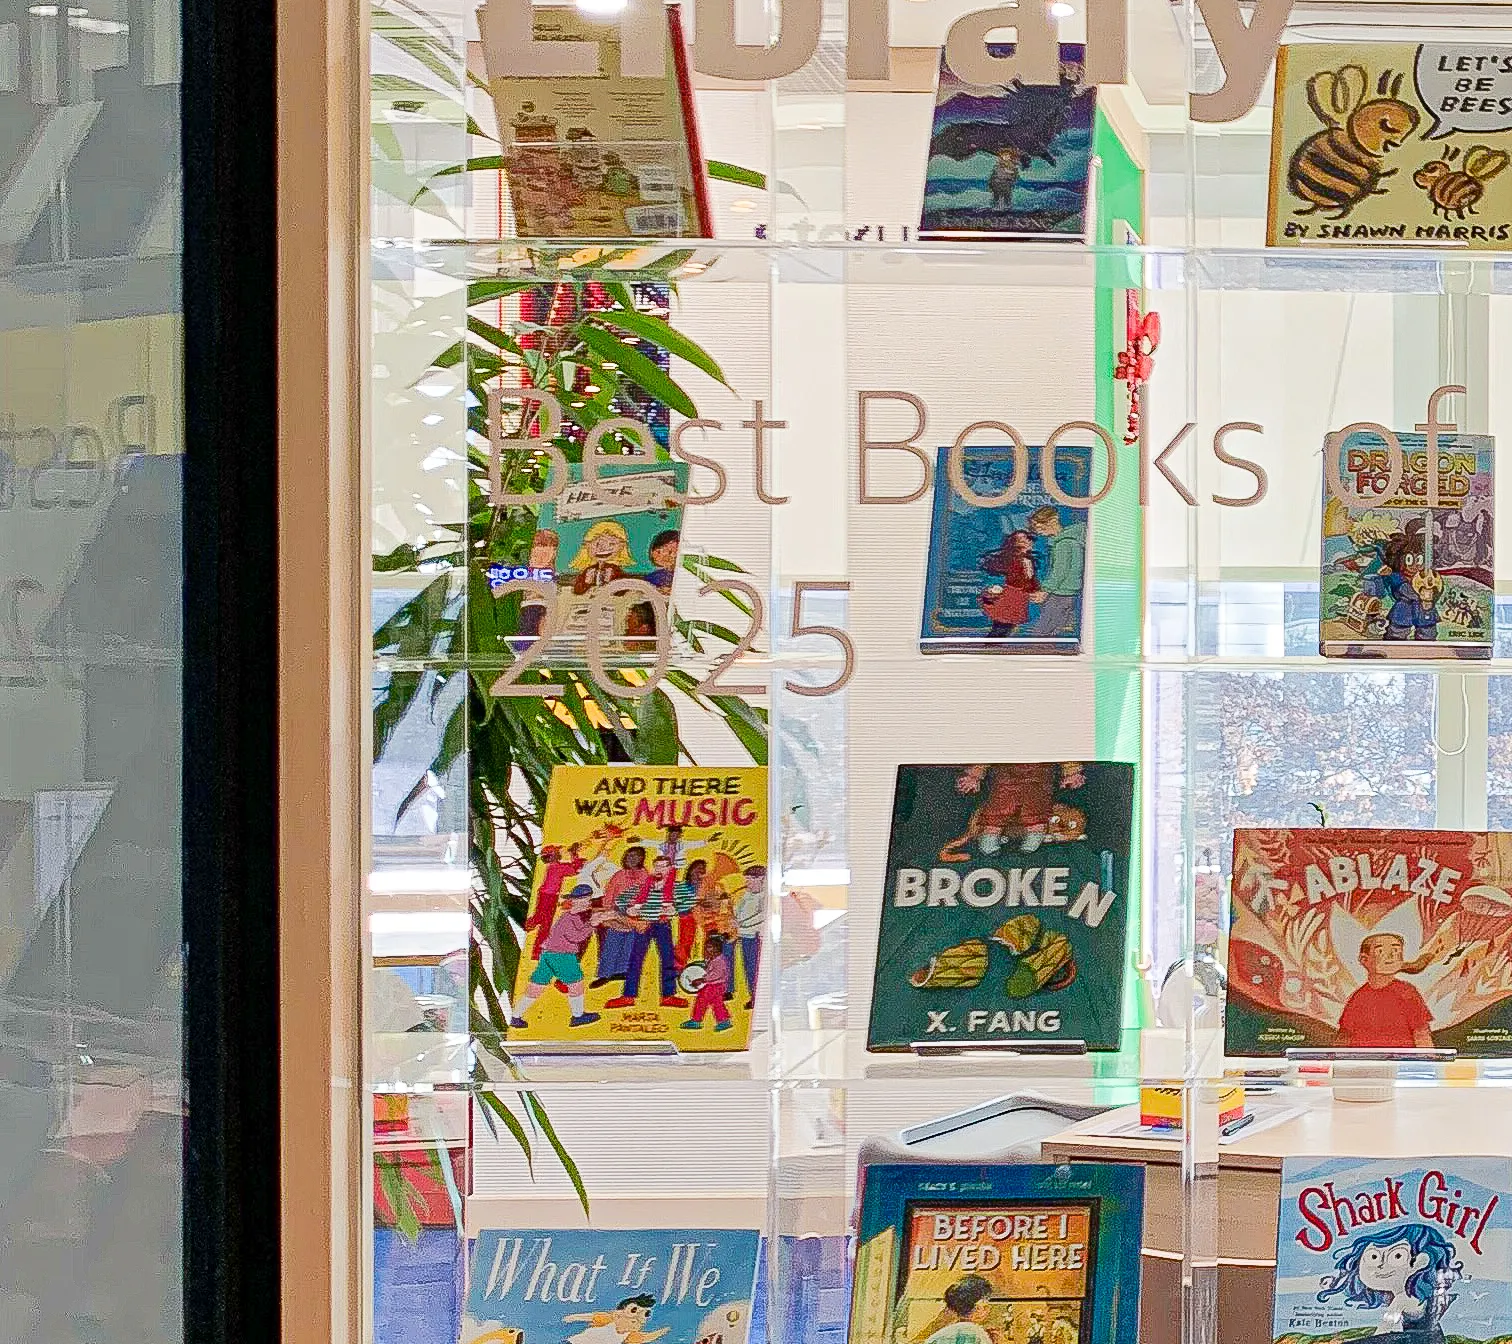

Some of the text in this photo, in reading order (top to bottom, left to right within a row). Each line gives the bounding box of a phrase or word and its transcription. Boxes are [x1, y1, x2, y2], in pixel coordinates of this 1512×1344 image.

[1454, 78, 1494, 92] BE
[1439, 97, 1512, 115] BEES
[1284, 222, 1511, 241] BY SHAWN HARRIS
[487, 382, 1468, 511] Best Books of
[489, 578, 856, 698] 2025
[593, 776, 741, 796] AND THERE
[575, 798, 758, 826] WAS MUSIC
[1304, 854, 1462, 905] ABLAZE
[894, 867, 1118, 928] BROKEN
[926, 1010, 1062, 1032] X. FANG
[1296, 1171, 1499, 1255] Shark Girl
[933, 1214, 1068, 1241] BEFORE I
[483, 1238, 607, 1303] What
[619, 1254, 656, 1288] If
[912, 1243, 1088, 1271] LIVED HERE
